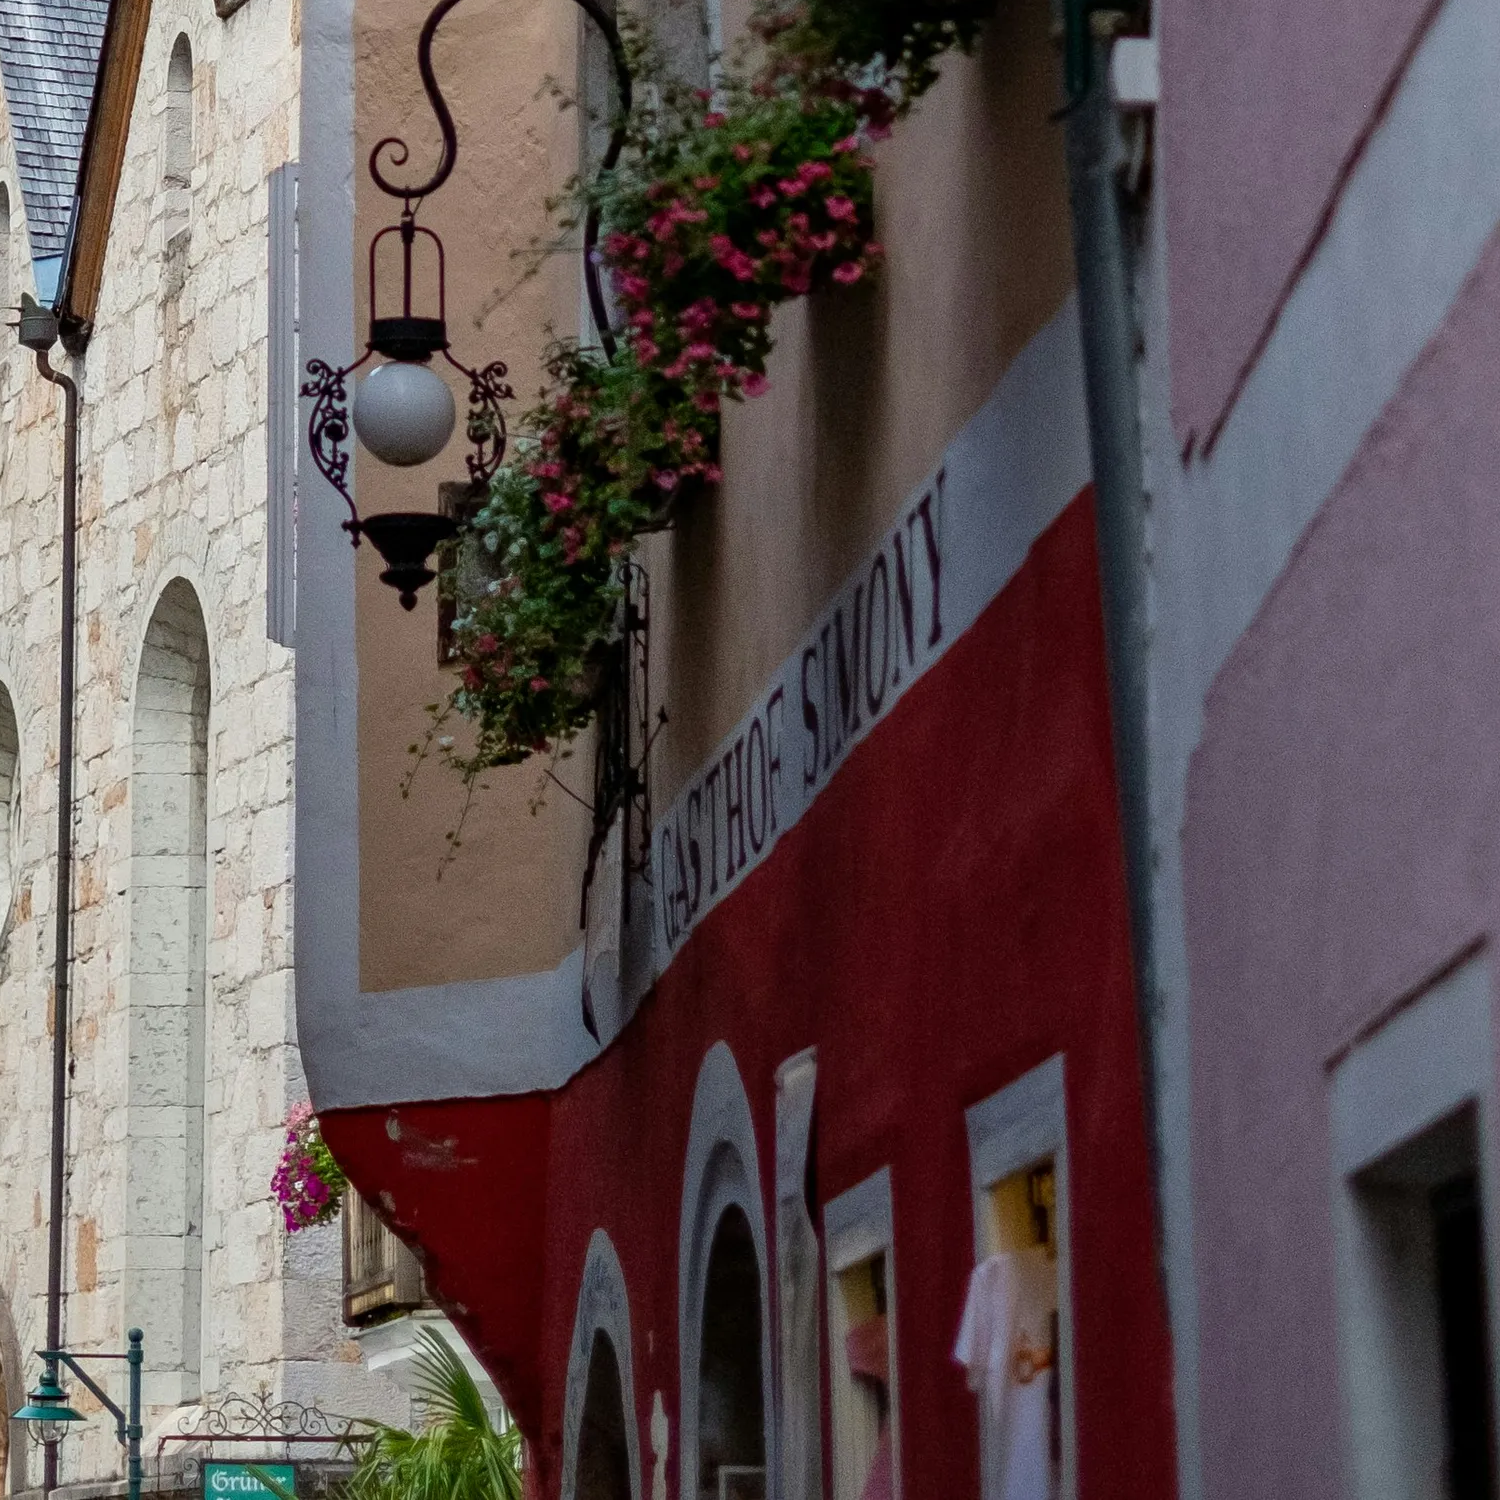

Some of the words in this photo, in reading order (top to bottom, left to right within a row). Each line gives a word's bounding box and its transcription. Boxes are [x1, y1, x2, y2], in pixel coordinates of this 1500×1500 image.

[662, 684, 784, 949] GASTHOF
[802, 468, 946, 788] SIMONY
[211, 1469, 287, 1491] Grün
